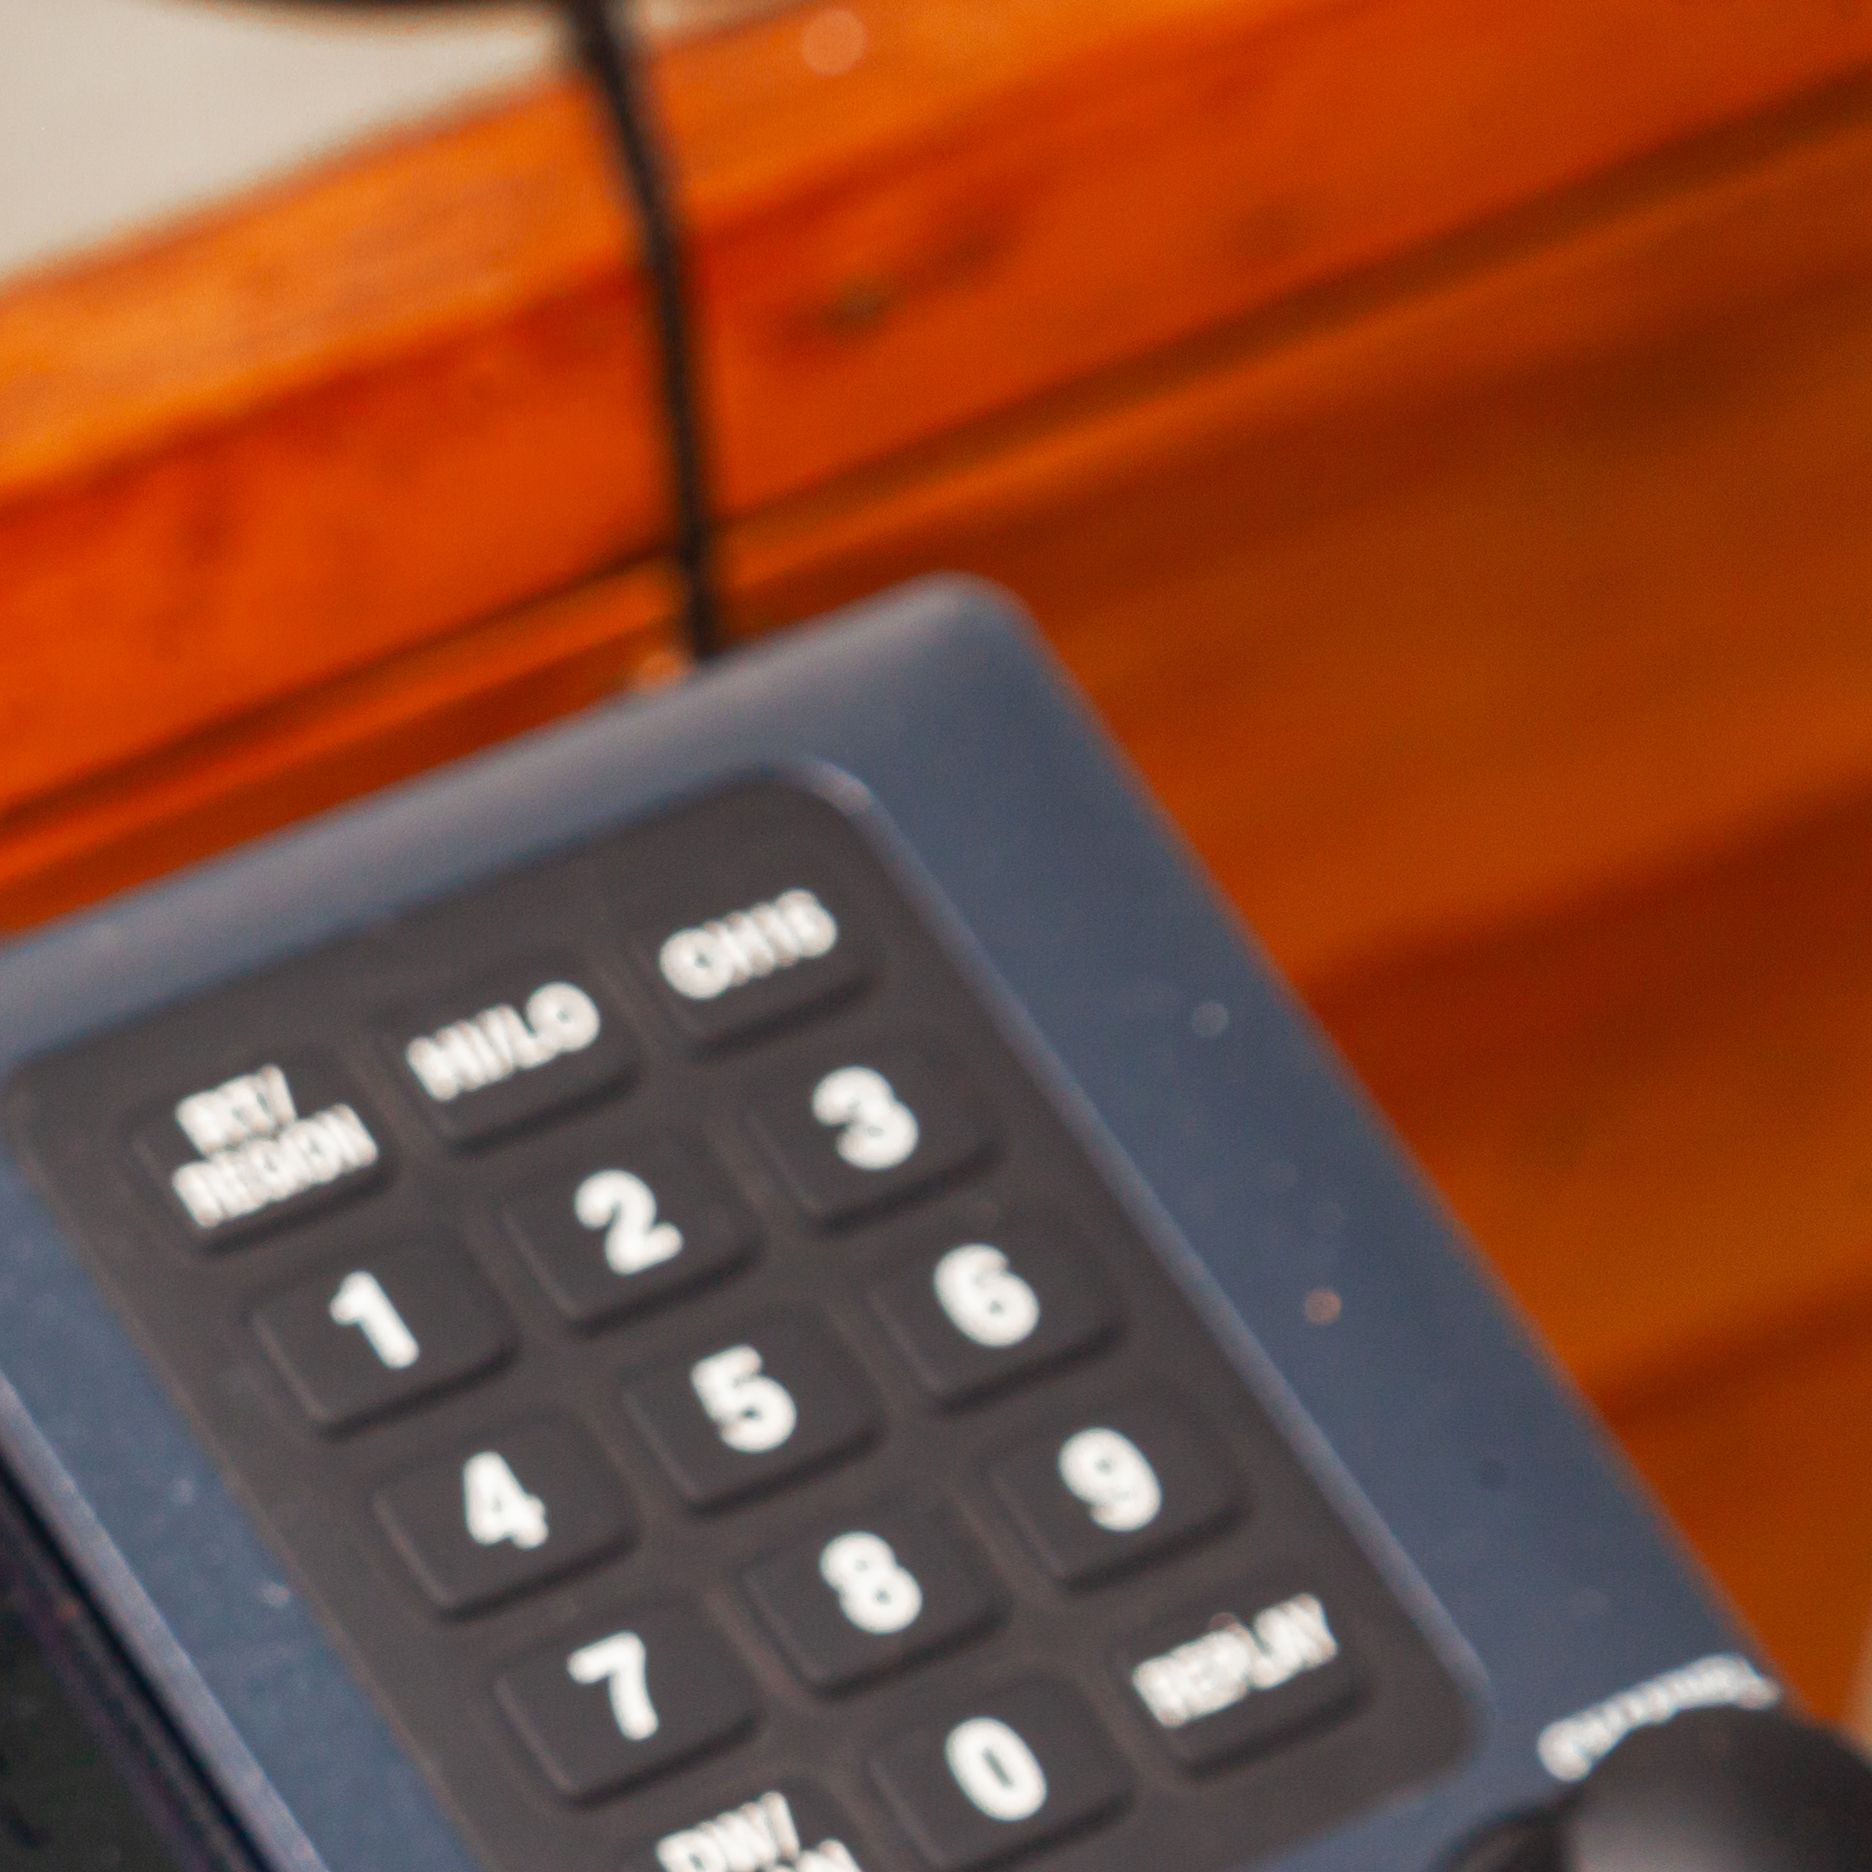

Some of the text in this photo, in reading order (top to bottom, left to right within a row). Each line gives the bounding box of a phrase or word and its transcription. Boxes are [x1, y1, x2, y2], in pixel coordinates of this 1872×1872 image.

[813, 1066, 919, 1170] 3
[574, 1169, 683, 1275] 2
[329, 1270, 420, 1370] 1
[933, 1243, 1040, 1347] 6
[690, 1344, 797, 1454] 5
[460, 1449, 550, 1550] 4
[1058, 1426, 1162, 1532] 9
[818, 1530, 923, 1633] 8
[567, 1631, 659, 1741] 7
[944, 1715, 1049, 1822] 0
